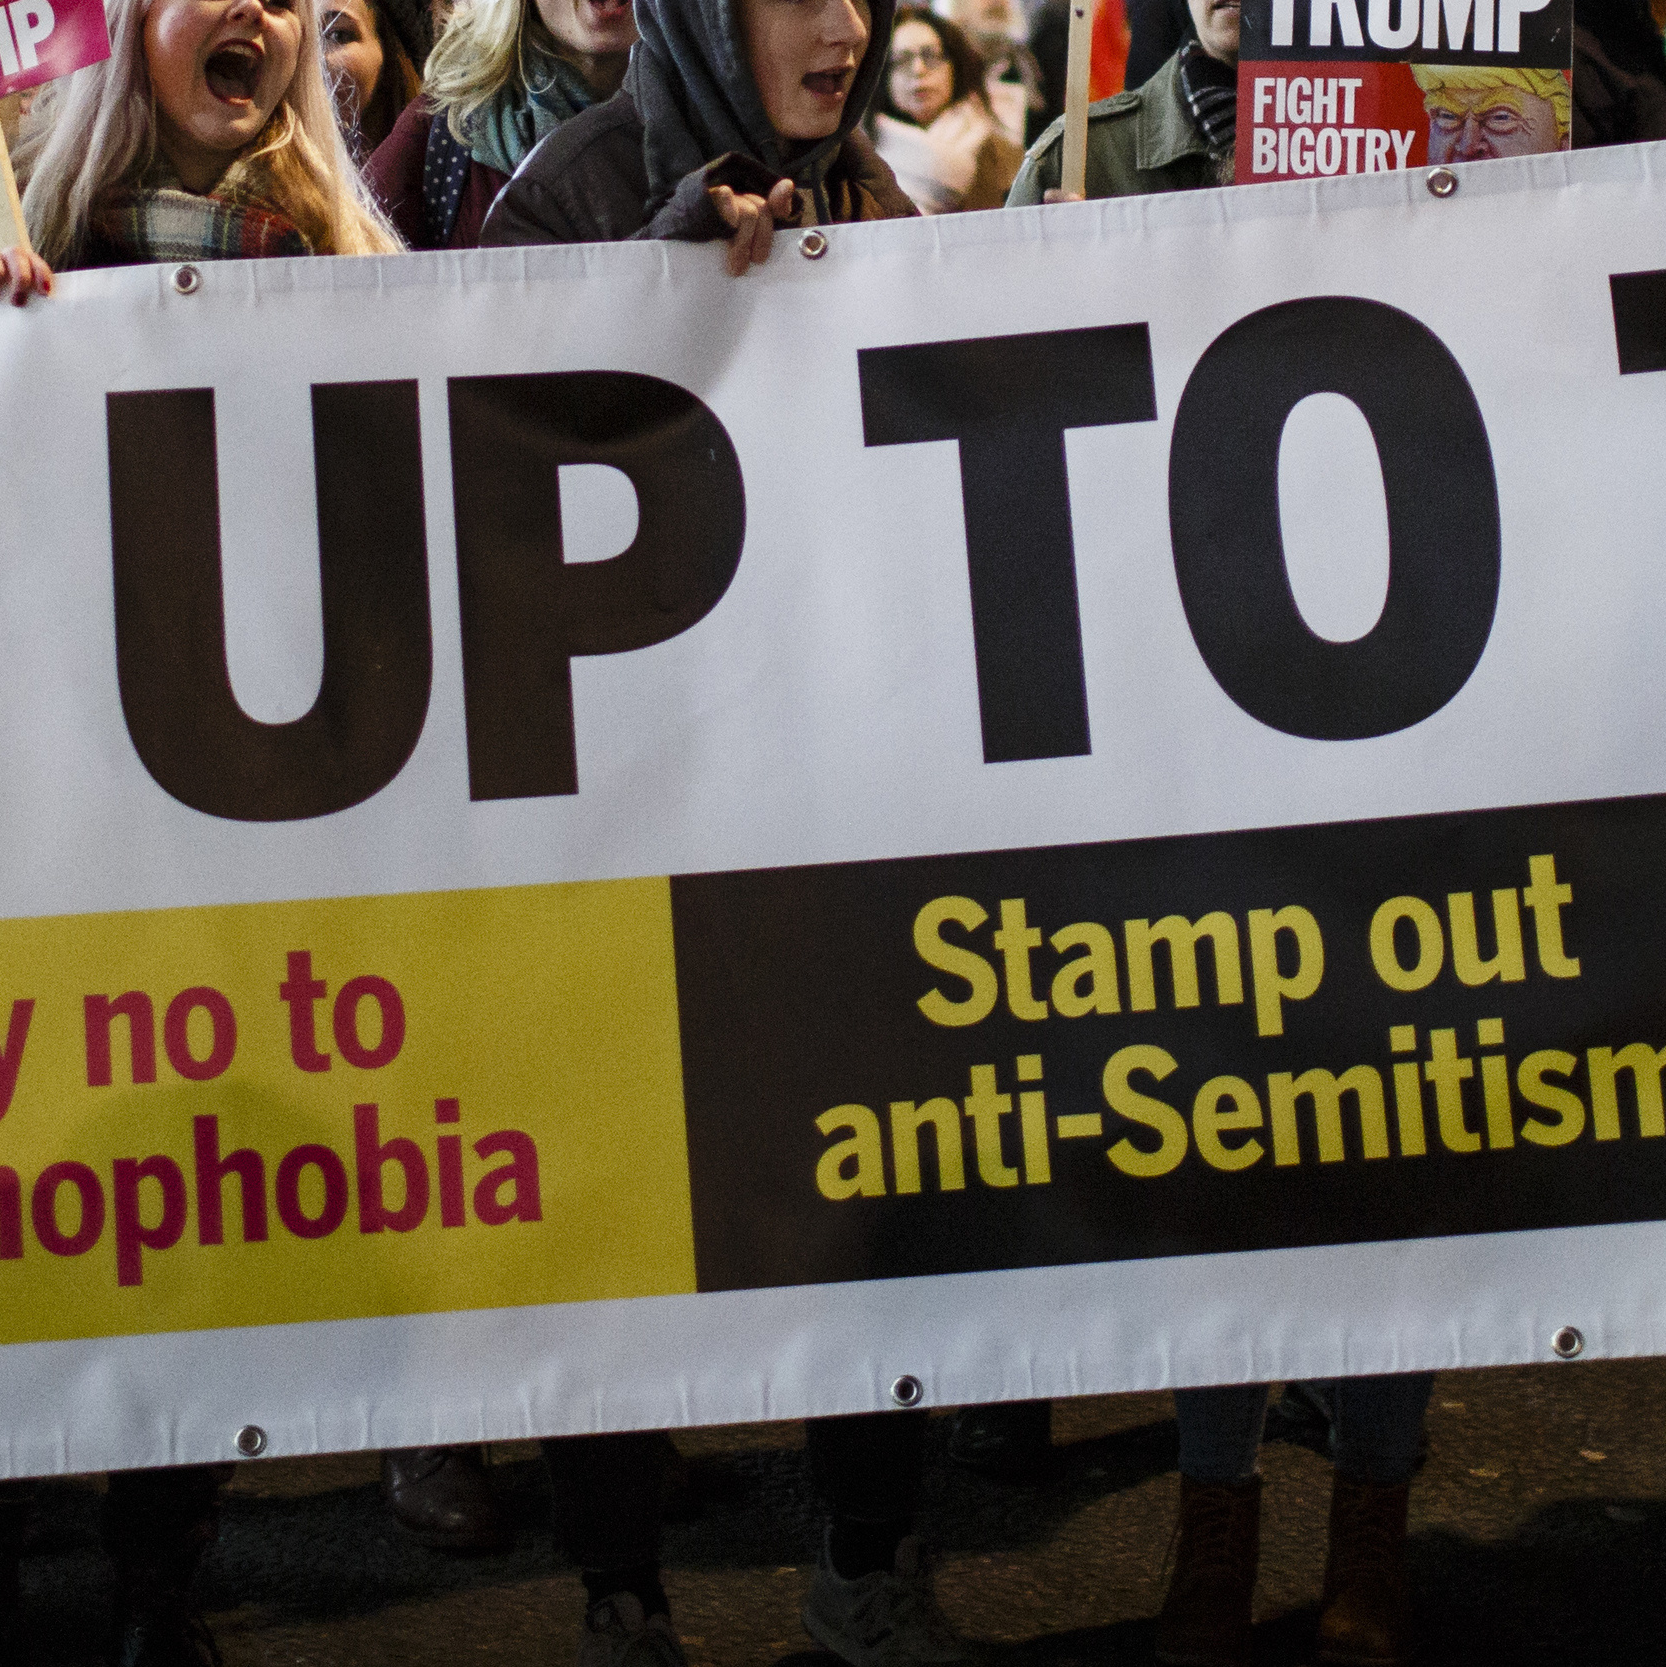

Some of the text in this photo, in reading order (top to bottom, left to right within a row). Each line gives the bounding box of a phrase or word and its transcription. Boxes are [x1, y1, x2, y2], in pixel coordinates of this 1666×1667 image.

[1252, 127, 1415, 175] BIGOTRY
[1253, 77, 1362, 124] FIGHT
[106, 370, 746, 822] UP
[857, 295, 1501, 763] TO
[912, 853, 1581, 1036] Stamp out
[84, 985, 237, 1088] no
[279, 949, 407, 1074] to
